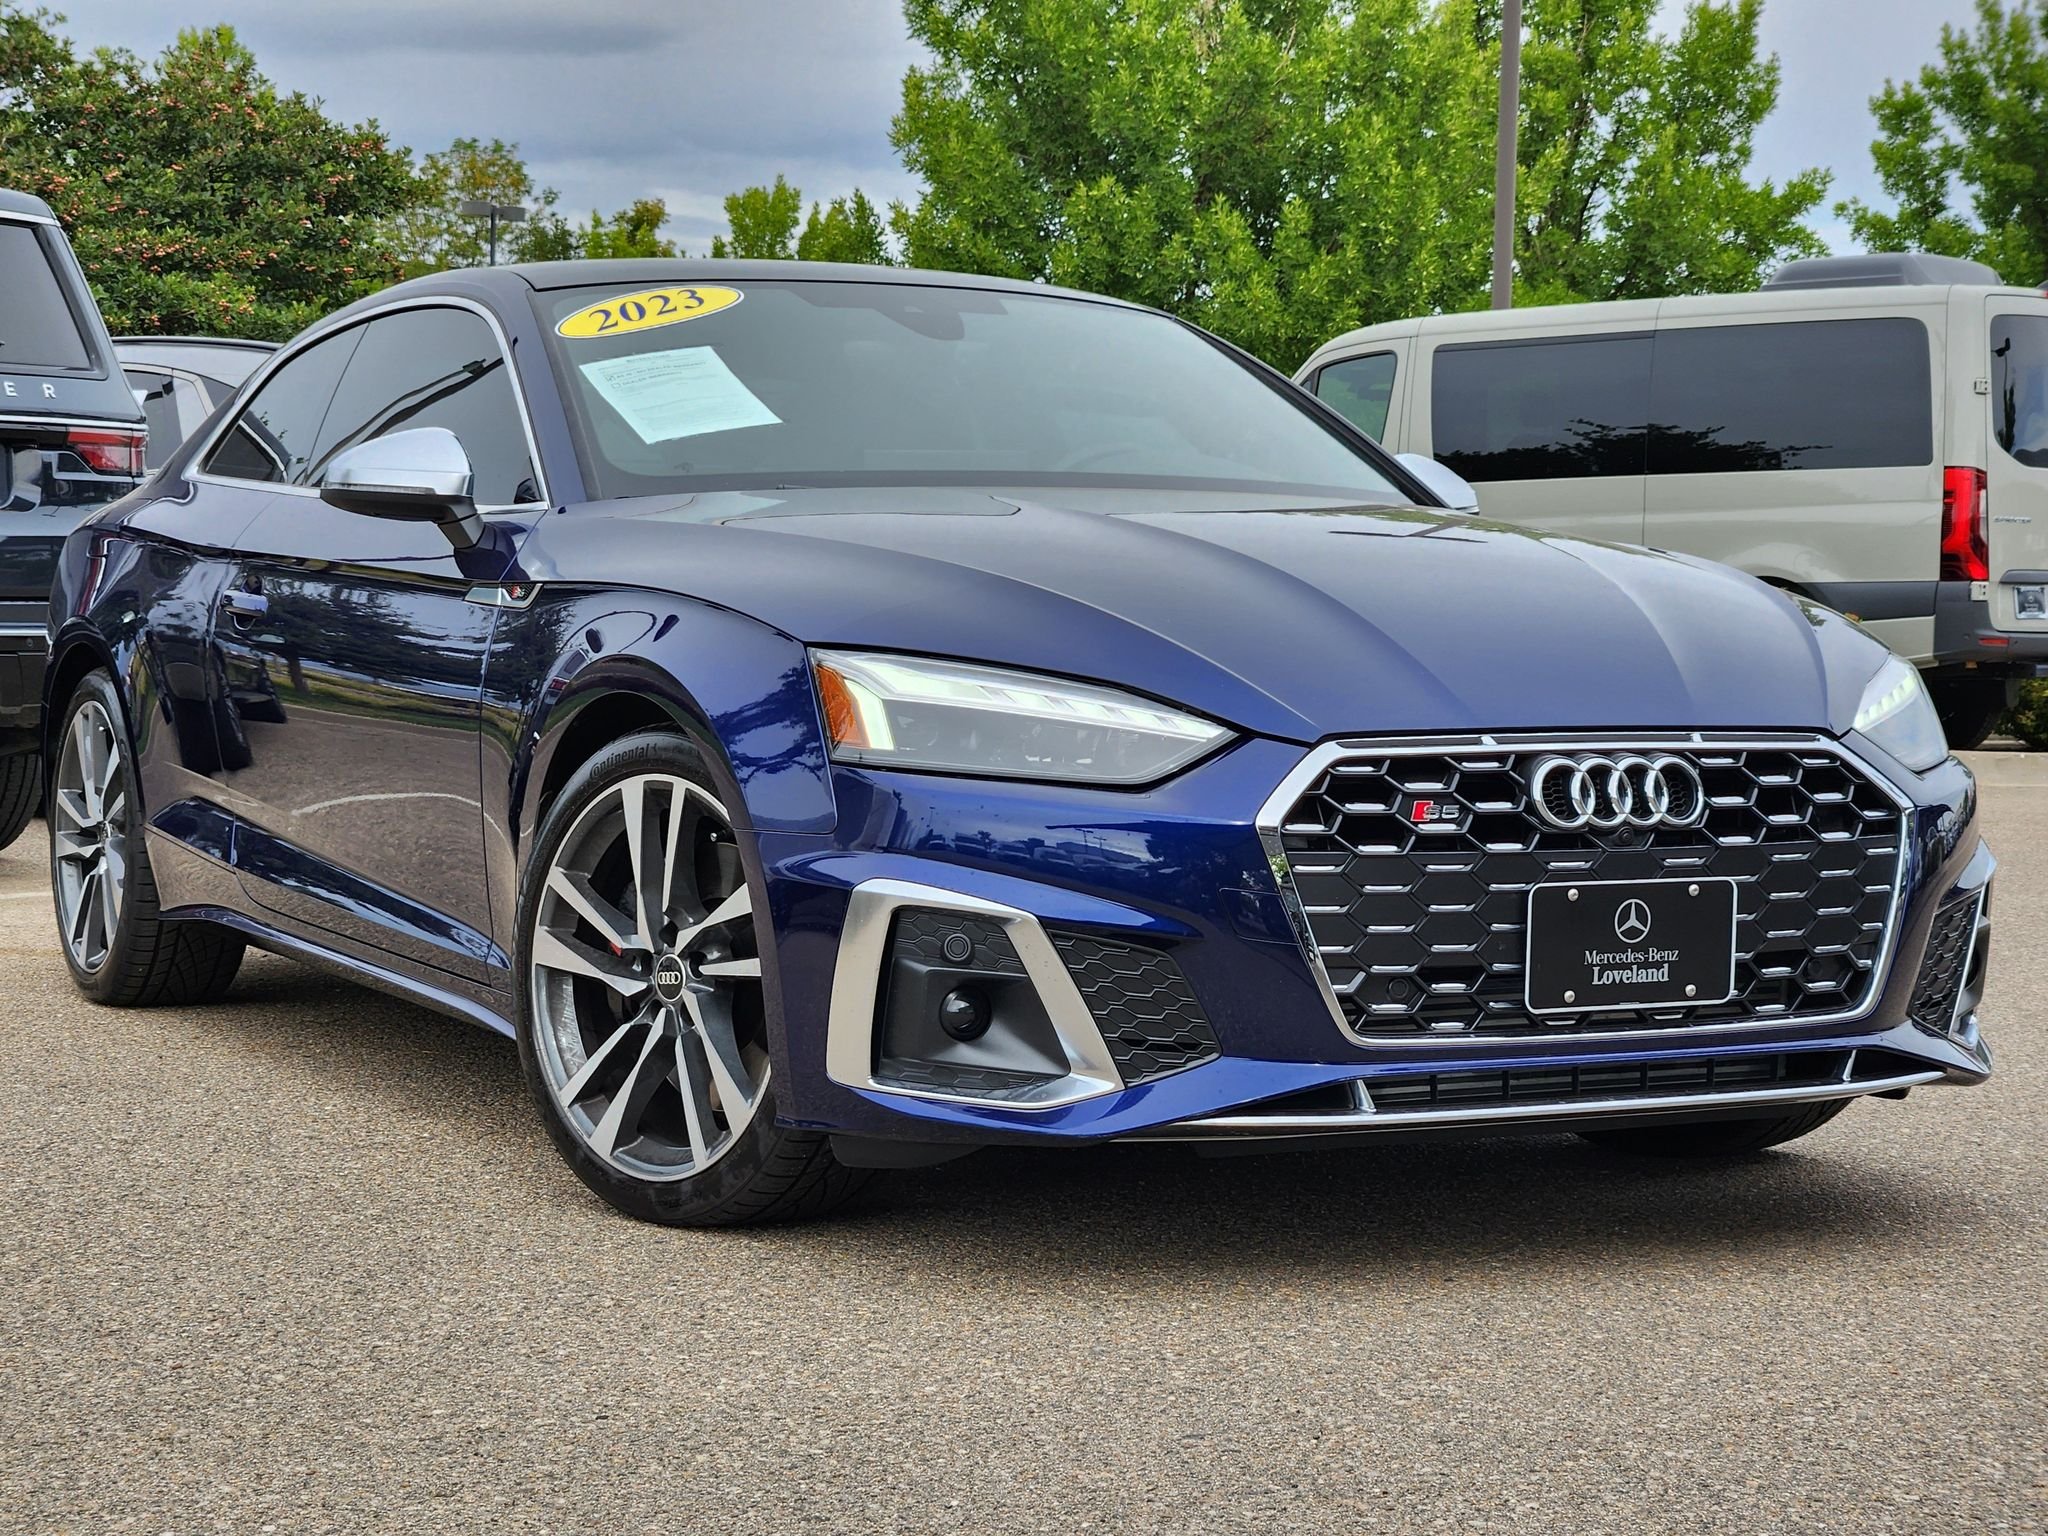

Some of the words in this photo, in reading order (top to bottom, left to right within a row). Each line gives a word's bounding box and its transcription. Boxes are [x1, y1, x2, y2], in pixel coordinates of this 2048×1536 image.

[588, 289, 705, 332] 2023
[589, 743, 649, 779] Continental
[1423, 804, 1460, 820] S5
[1584, 947, 1679, 966] Mercedes-Benz
[1591, 963, 1670, 985] Loveland
